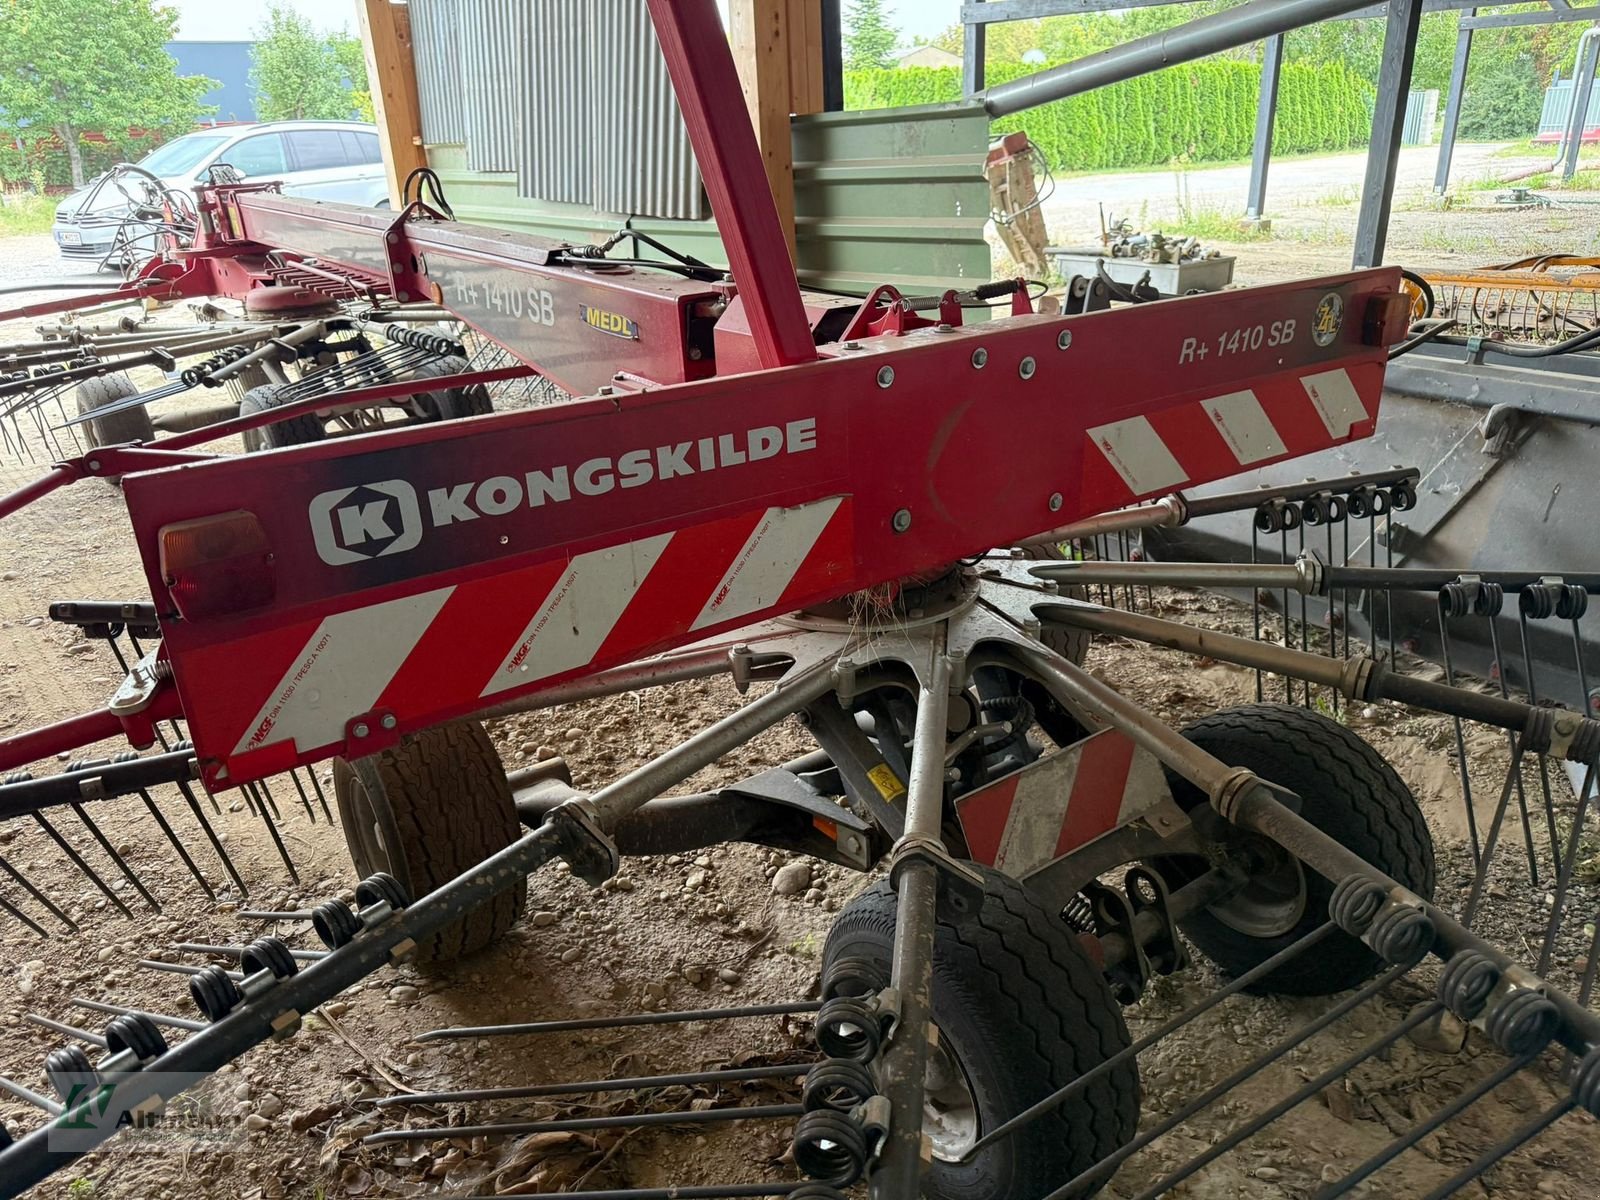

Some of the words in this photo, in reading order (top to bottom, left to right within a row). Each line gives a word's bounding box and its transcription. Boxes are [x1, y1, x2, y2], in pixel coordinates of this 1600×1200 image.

[455, 271, 478, 305] R+
[482, 281, 523, 319] 1410
[527, 287, 555, 327] SB
[586, 307, 633, 336] MEDL
[1179, 338, 1209, 364] R+
[1218, 325, 1264, 357] 1410
[1268, 319, 1297, 347] SB
[427, 417, 818, 528] KONGSKILDE
[727, 576, 736, 587] DIN
[733, 560, 746, 576] 11030
[759, 520, 772, 537] 10071
[527, 633, 537, 645] DIN
[534, 616, 548, 633] 11030
[547, 592, 564, 613] TPESC
[565, 571, 579, 588] 10071
[269, 705, 281, 719] DIN
[279, 685, 296, 705] 11030
[315, 633, 332, 652] 10071
